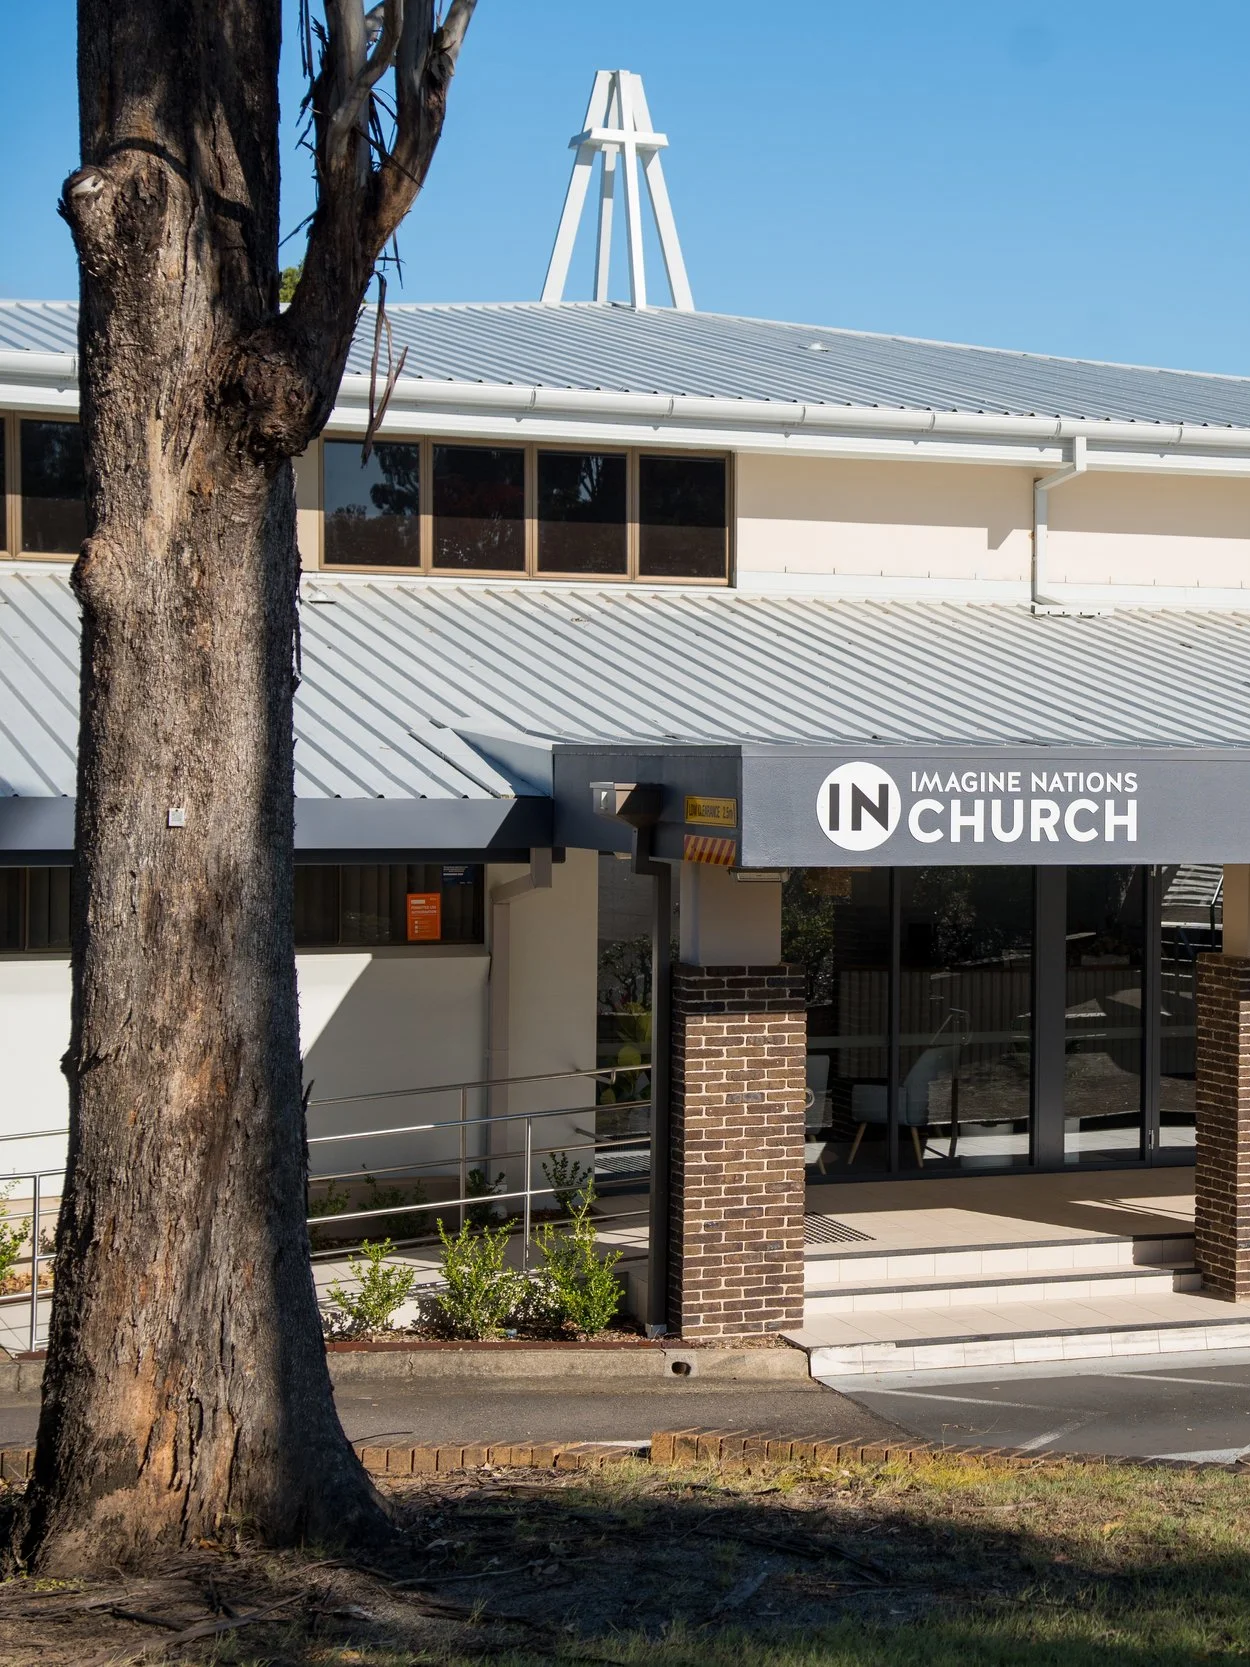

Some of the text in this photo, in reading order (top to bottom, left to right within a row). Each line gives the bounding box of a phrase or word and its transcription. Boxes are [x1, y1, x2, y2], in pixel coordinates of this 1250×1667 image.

[911, 771, 1138, 793] IMAGINE NATIONS
[688, 803, 698, 817] LOW
[698, 804, 721, 819] CLEARANCE
[828, 783, 890, 832] IN
[908, 798, 1138, 844] CHURCH
